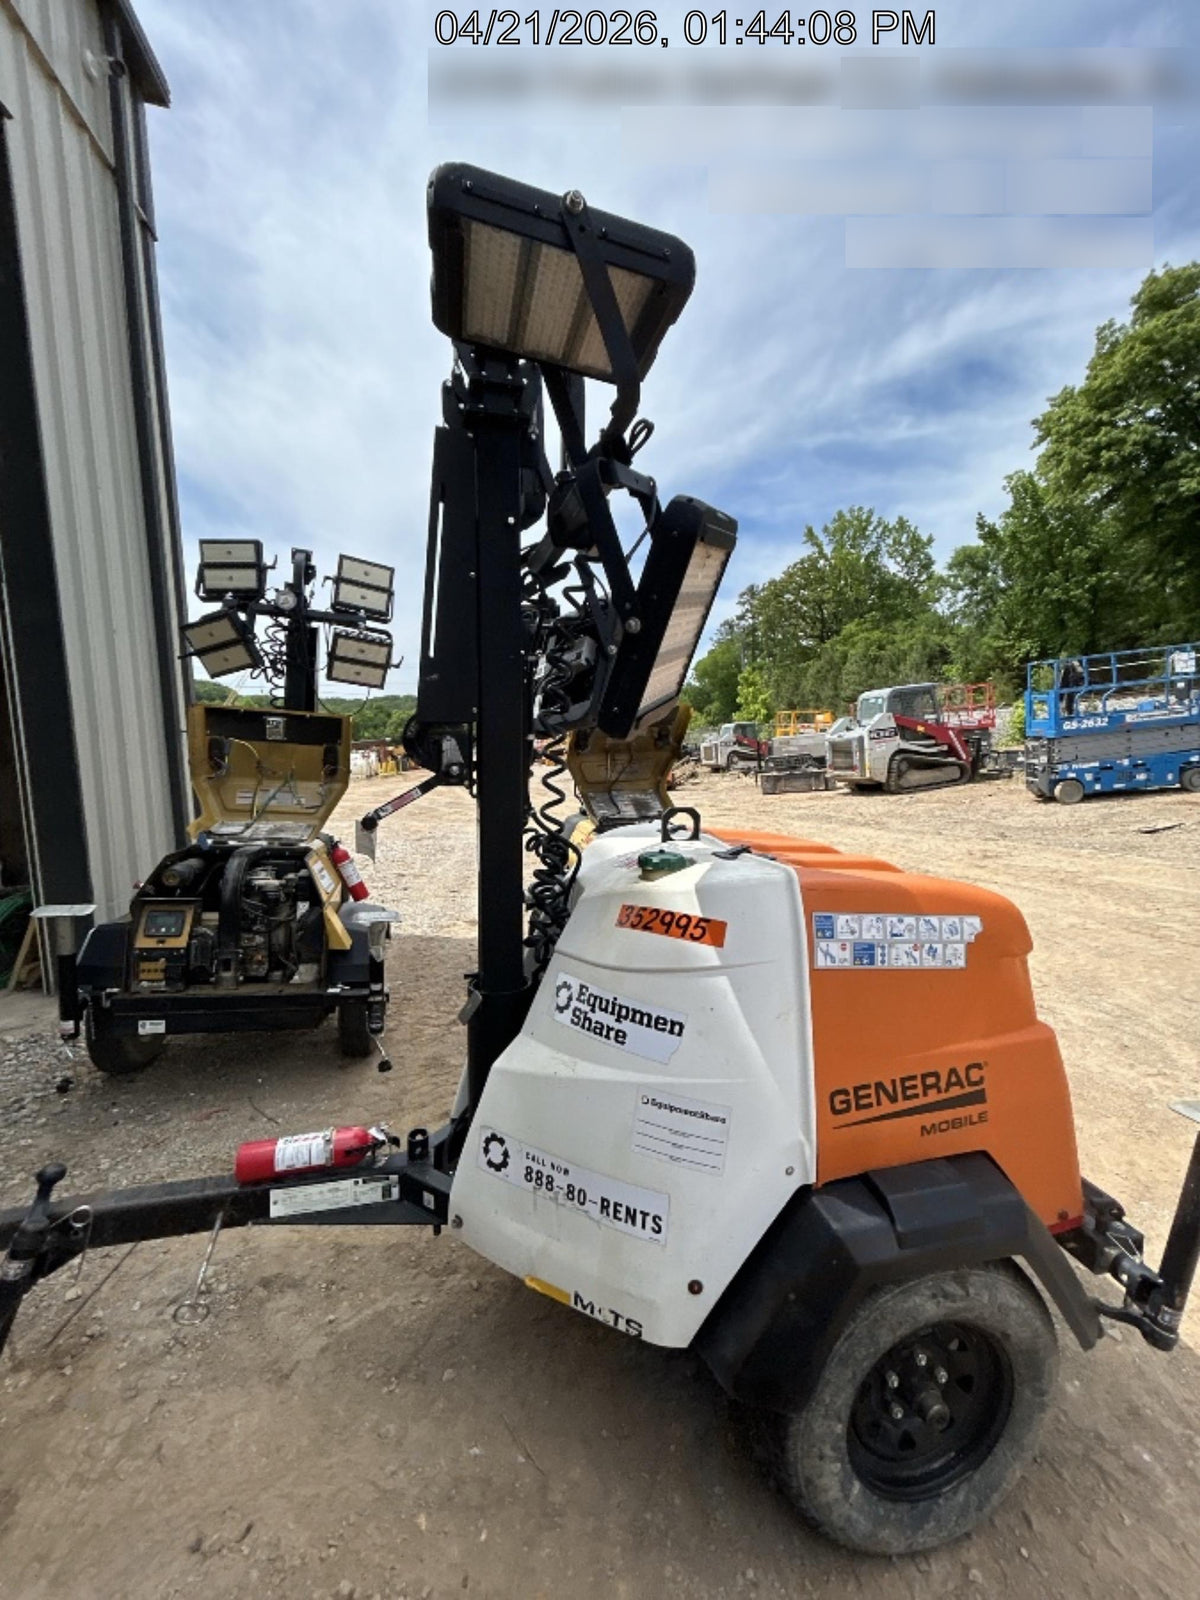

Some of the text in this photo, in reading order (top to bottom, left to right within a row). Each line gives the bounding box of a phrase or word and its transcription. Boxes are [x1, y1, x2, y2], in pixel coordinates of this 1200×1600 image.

[615, 904, 711, 941] 352995
[570, 1006, 627, 1046] Share
[575, 982, 685, 1037] Equipmen
[829, 1062, 985, 1116] GENERAC
[920, 1111, 988, 1137] MOBILE
[525, 1151, 570, 1177] CALL NOW
[524, 1165, 663, 1235] 888-80-RENTS
[573, 1290, 643, 1339] MTS
